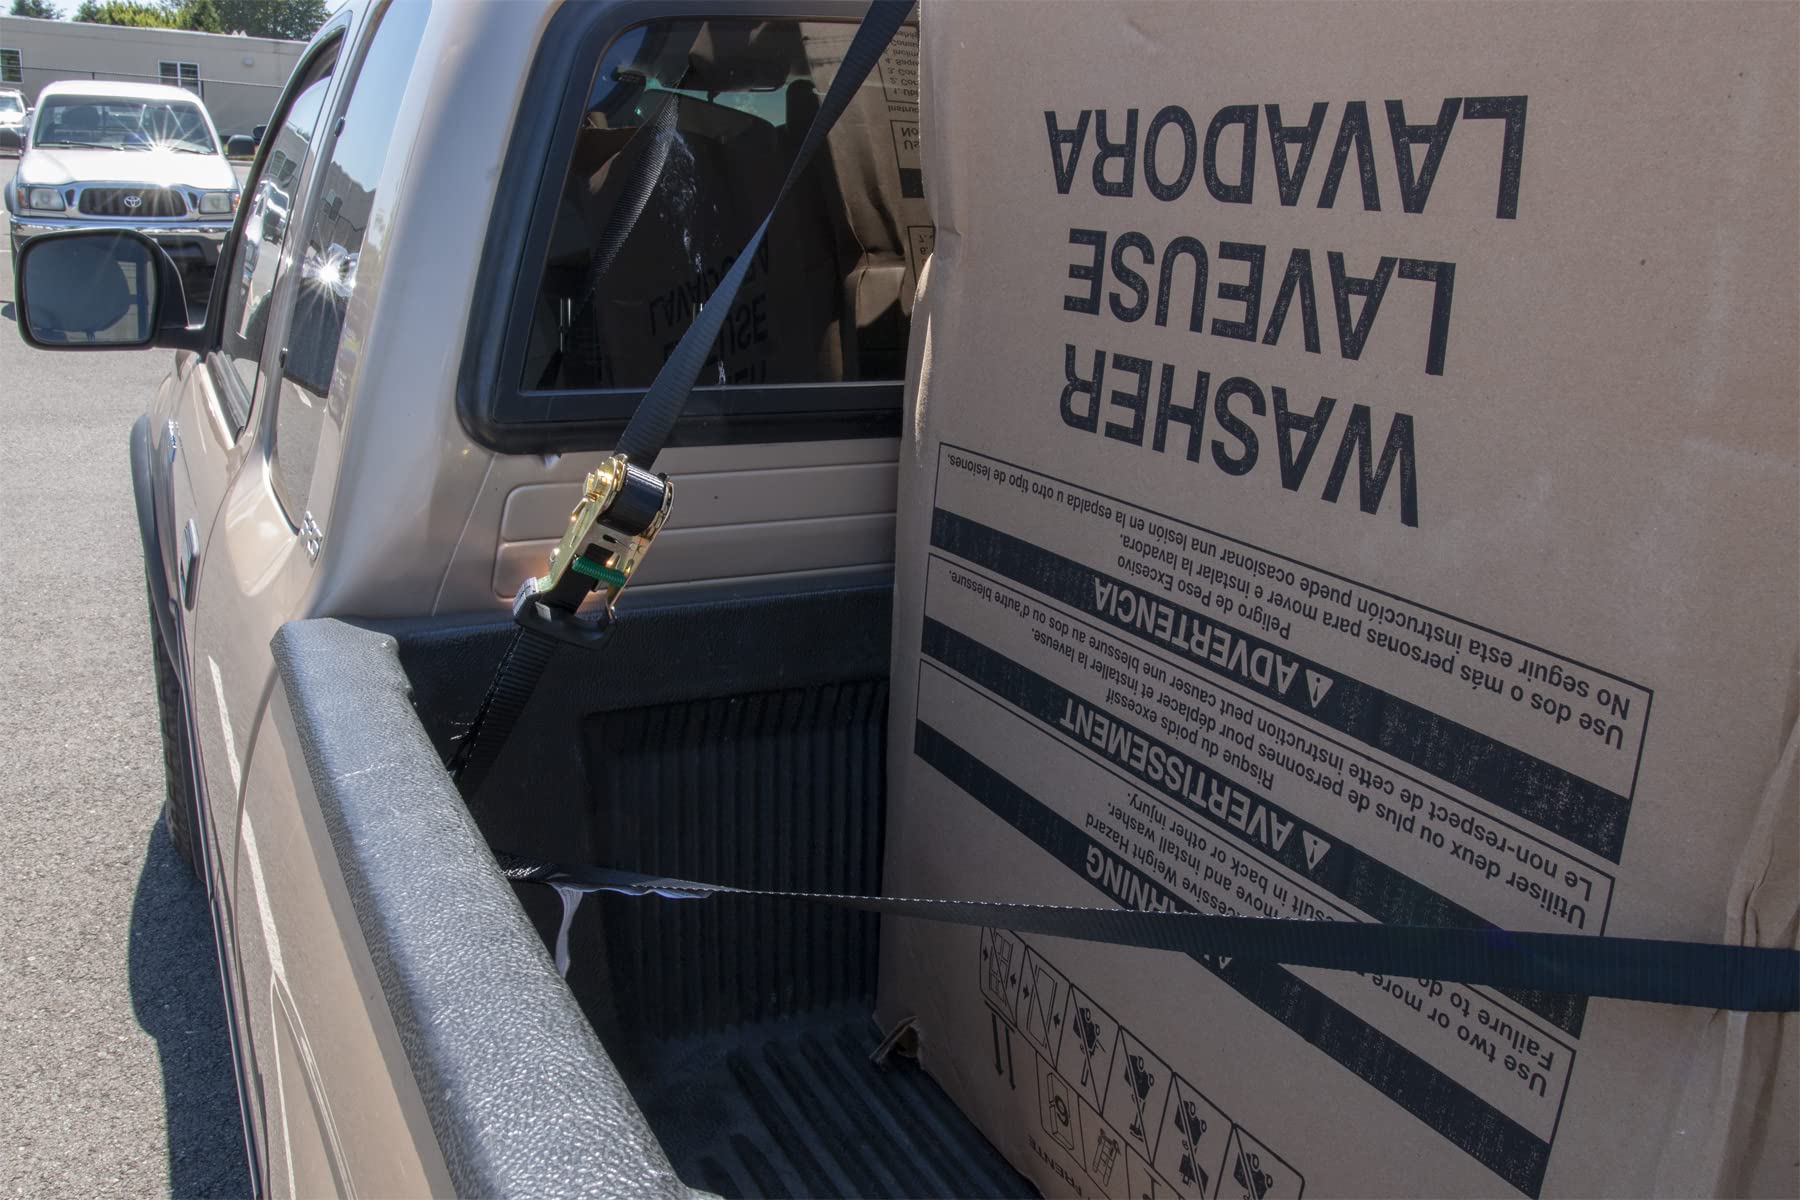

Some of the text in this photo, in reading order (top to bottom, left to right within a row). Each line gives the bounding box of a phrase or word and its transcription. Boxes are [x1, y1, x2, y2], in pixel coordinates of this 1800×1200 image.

[1044, 95, 1528, 219] LAVADORA
[1063, 228, 1456, 376] LAVEUSE
[1059, 344, 1418, 527] WASHER
[947, 454, 1630, 721] No seguir esta instrucción puede ocasionar una lesión en la espalda u otro tipo de lesiones.
[949, 570, 992, 604] blessure.
[1117, 555, 1291, 640] Peligro de Peso Excesivo
[1032, 609, 1046, 623] ou
[1048, 617, 1069, 637] dos
[1072, 628, 1086, 643] au
[1094, 576, 1299, 694] ADVERTENCIA
[1088, 636, 1140, 674] blessure
[1120, 534, 1623, 750] Use dos o más personas para mover e instalar la lavadora.
[1142, 663, 1166, 683] une
[1168, 676, 1216, 707] causer
[1219, 698, 1254, 726] peut
[1105, 688, 1274, 791] Risque du poids excessif
[1257, 717, 1344, 776] instruction
[1031, 628, 1586, 929] Utiliser deux ou plus de personnes pour déplacer et installer la laveuse.
[1060, 699, 1294, 851] AVERTISSEMENT
[1349, 762, 1394, 795] cette
[1127, 792, 1166, 830] injury.
[1400, 788, 1423, 812] de
[1085, 812, 1130, 854] Hazard
[1169, 821, 1206, 851] other
[1428, 801, 1557, 879] non-respect
[1132, 846, 1176, 887] Weight
[1210, 846, 1226, 863] or
[1230, 856, 1268, 895] back
[1272, 883, 1287, 907] in
[1564, 870, 1592, 903] Le
[1107, 802, 1546, 1097] Use two or more move and install washer.
[1450, 992, 1469, 1018] to
[1478, 1009, 1554, 1071] Failure
